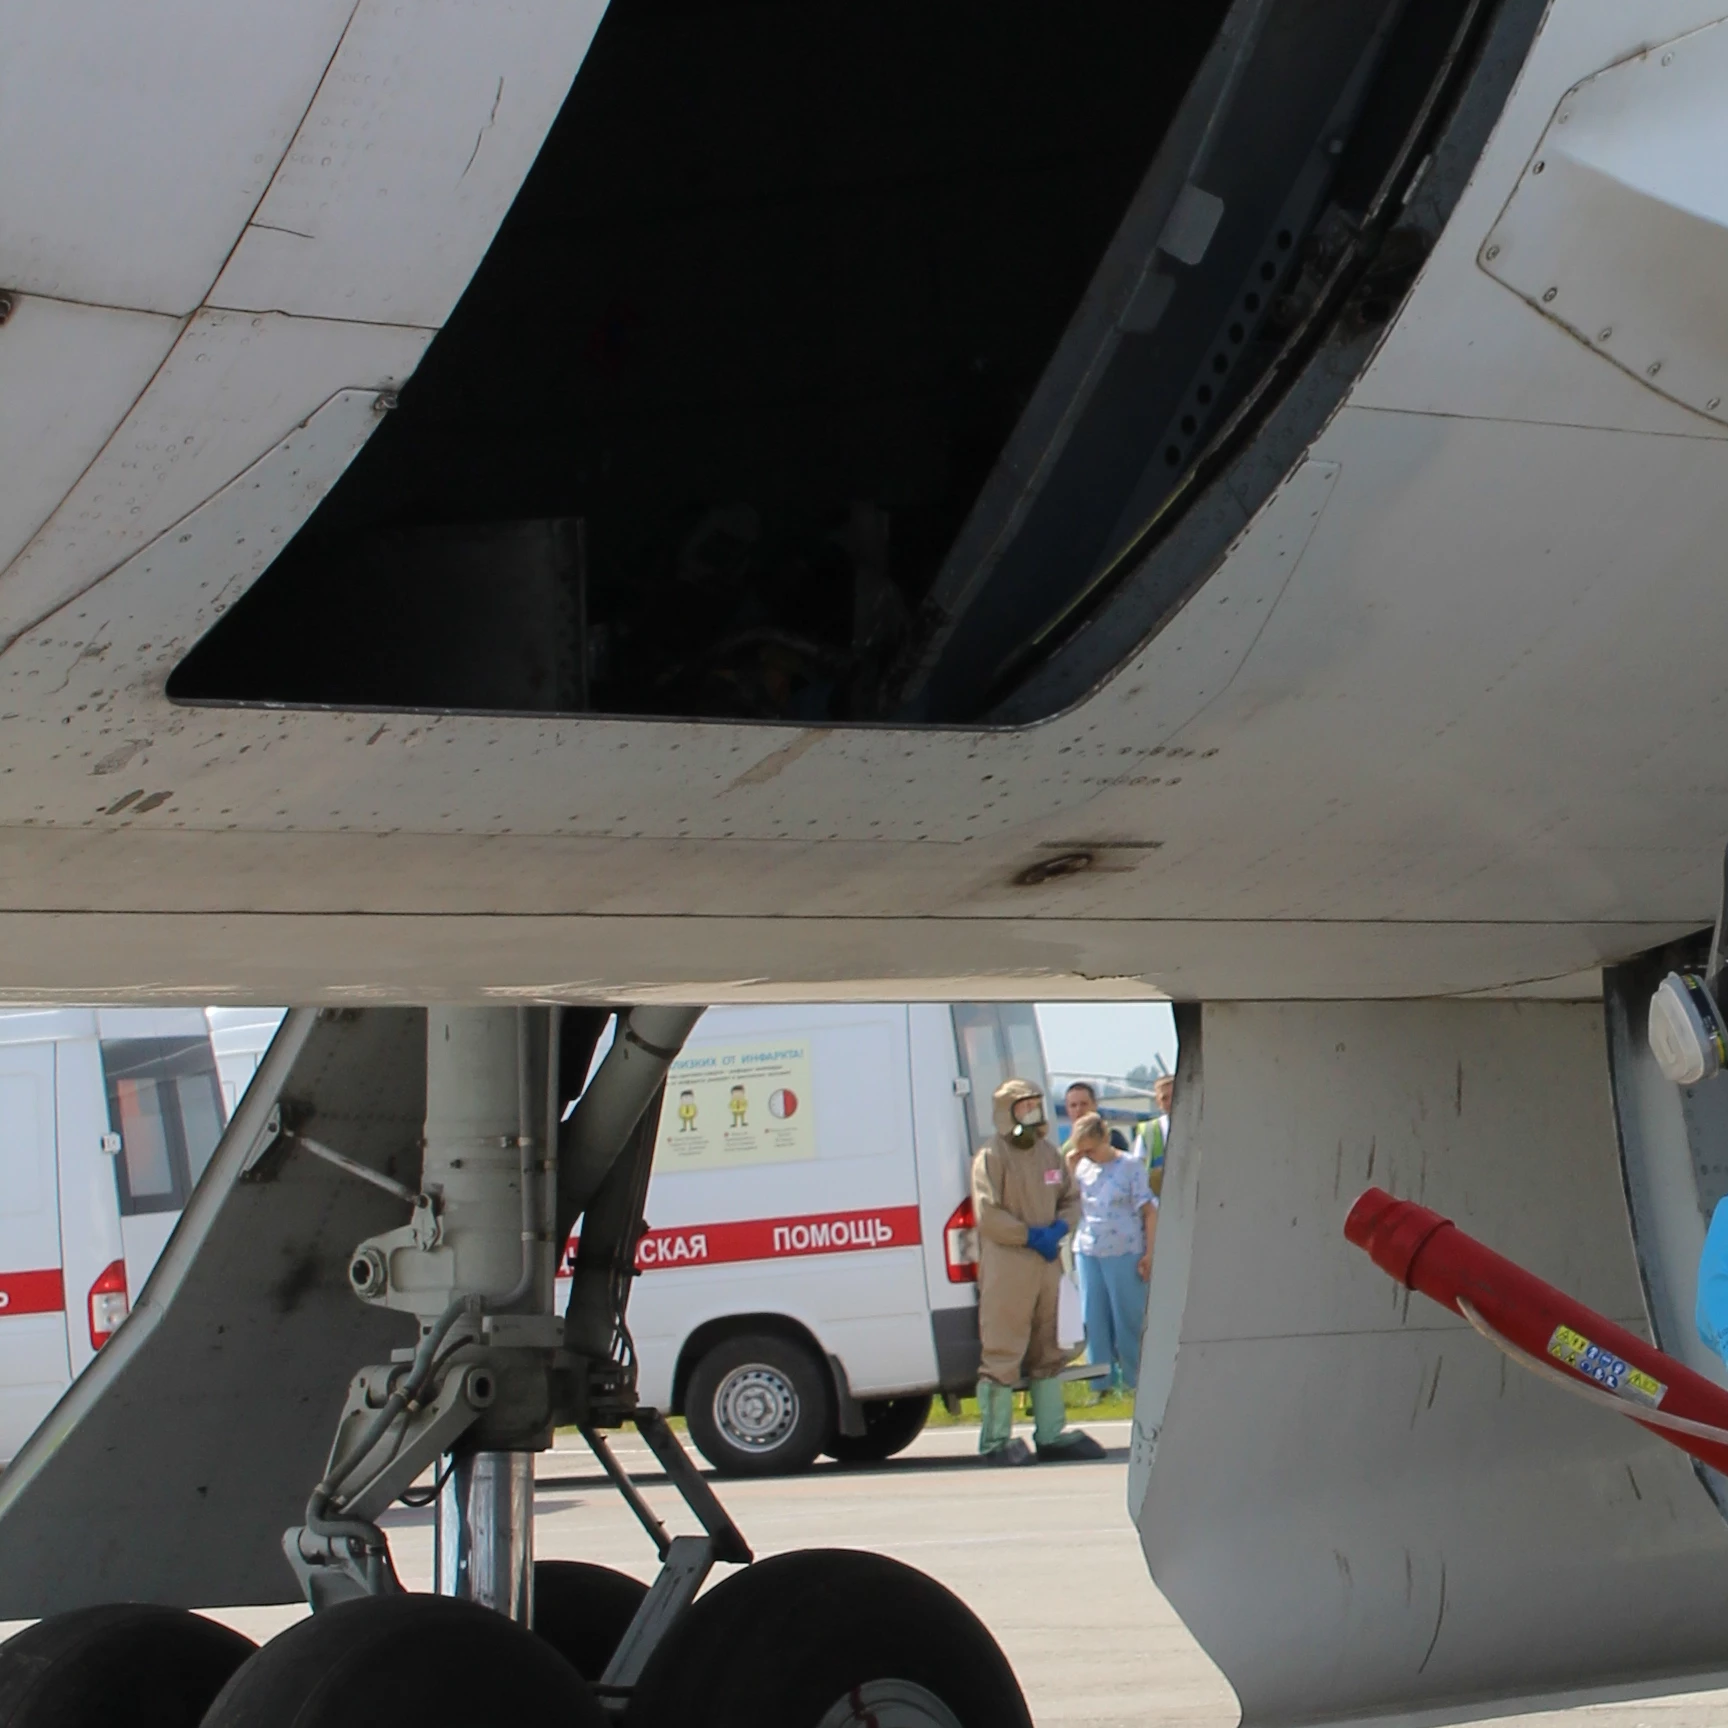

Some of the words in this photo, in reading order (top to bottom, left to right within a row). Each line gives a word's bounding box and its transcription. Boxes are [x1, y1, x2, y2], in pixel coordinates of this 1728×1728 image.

[670, 1057, 717, 1070] ЛИЗКИХ
[722, 1055, 736, 1066] ОТ
[741, 1049, 804, 1063] ИНФАРКТА!
[634, 1234, 708, 1264] СКАЯ
[773, 1218, 893, 1251] ПОМОЩЬ
